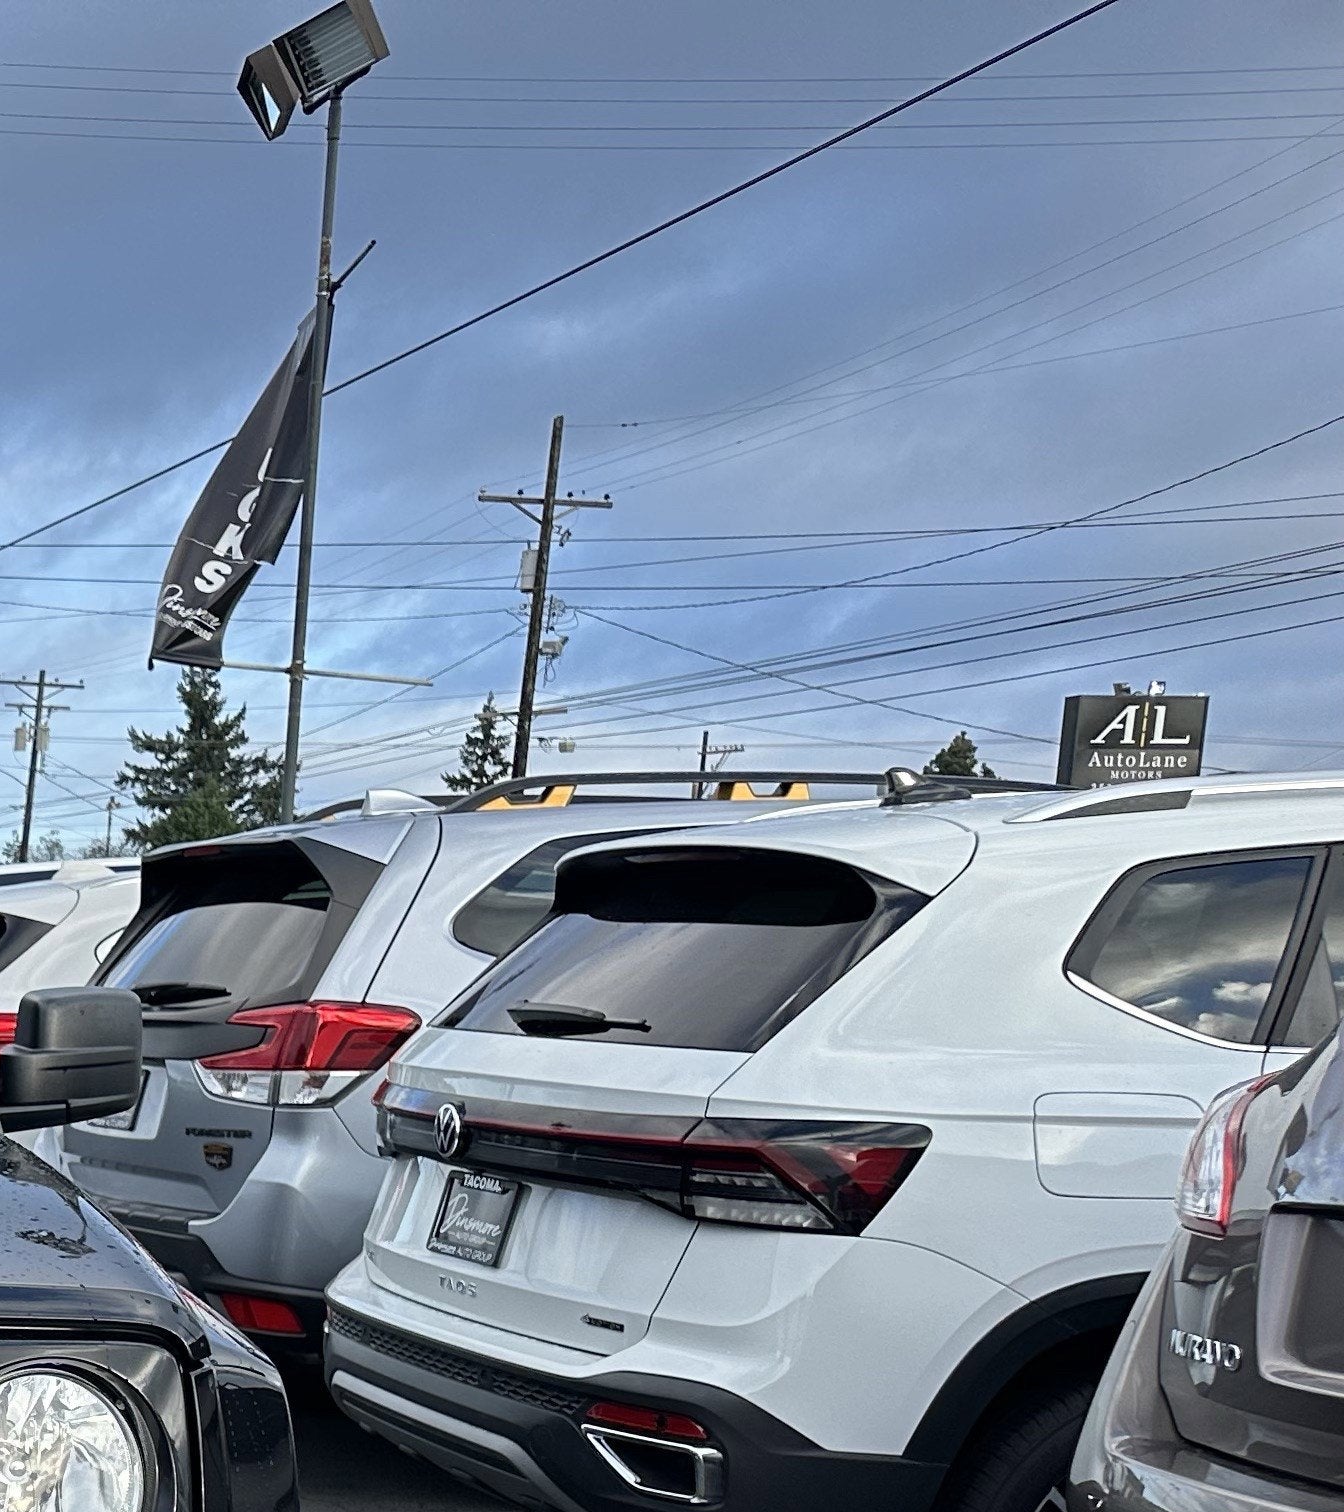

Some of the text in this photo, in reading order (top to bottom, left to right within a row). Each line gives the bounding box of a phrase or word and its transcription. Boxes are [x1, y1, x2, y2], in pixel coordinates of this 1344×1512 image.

[1088, 751, 1188, 768] AutoLane
[1110, 770, 1163, 780] MOTORS
[439, 1193, 502, 1237] Dinsmore
[438, 1273, 478, 1297] TAOS
[1169, 1329, 1242, 1371] MURANO
